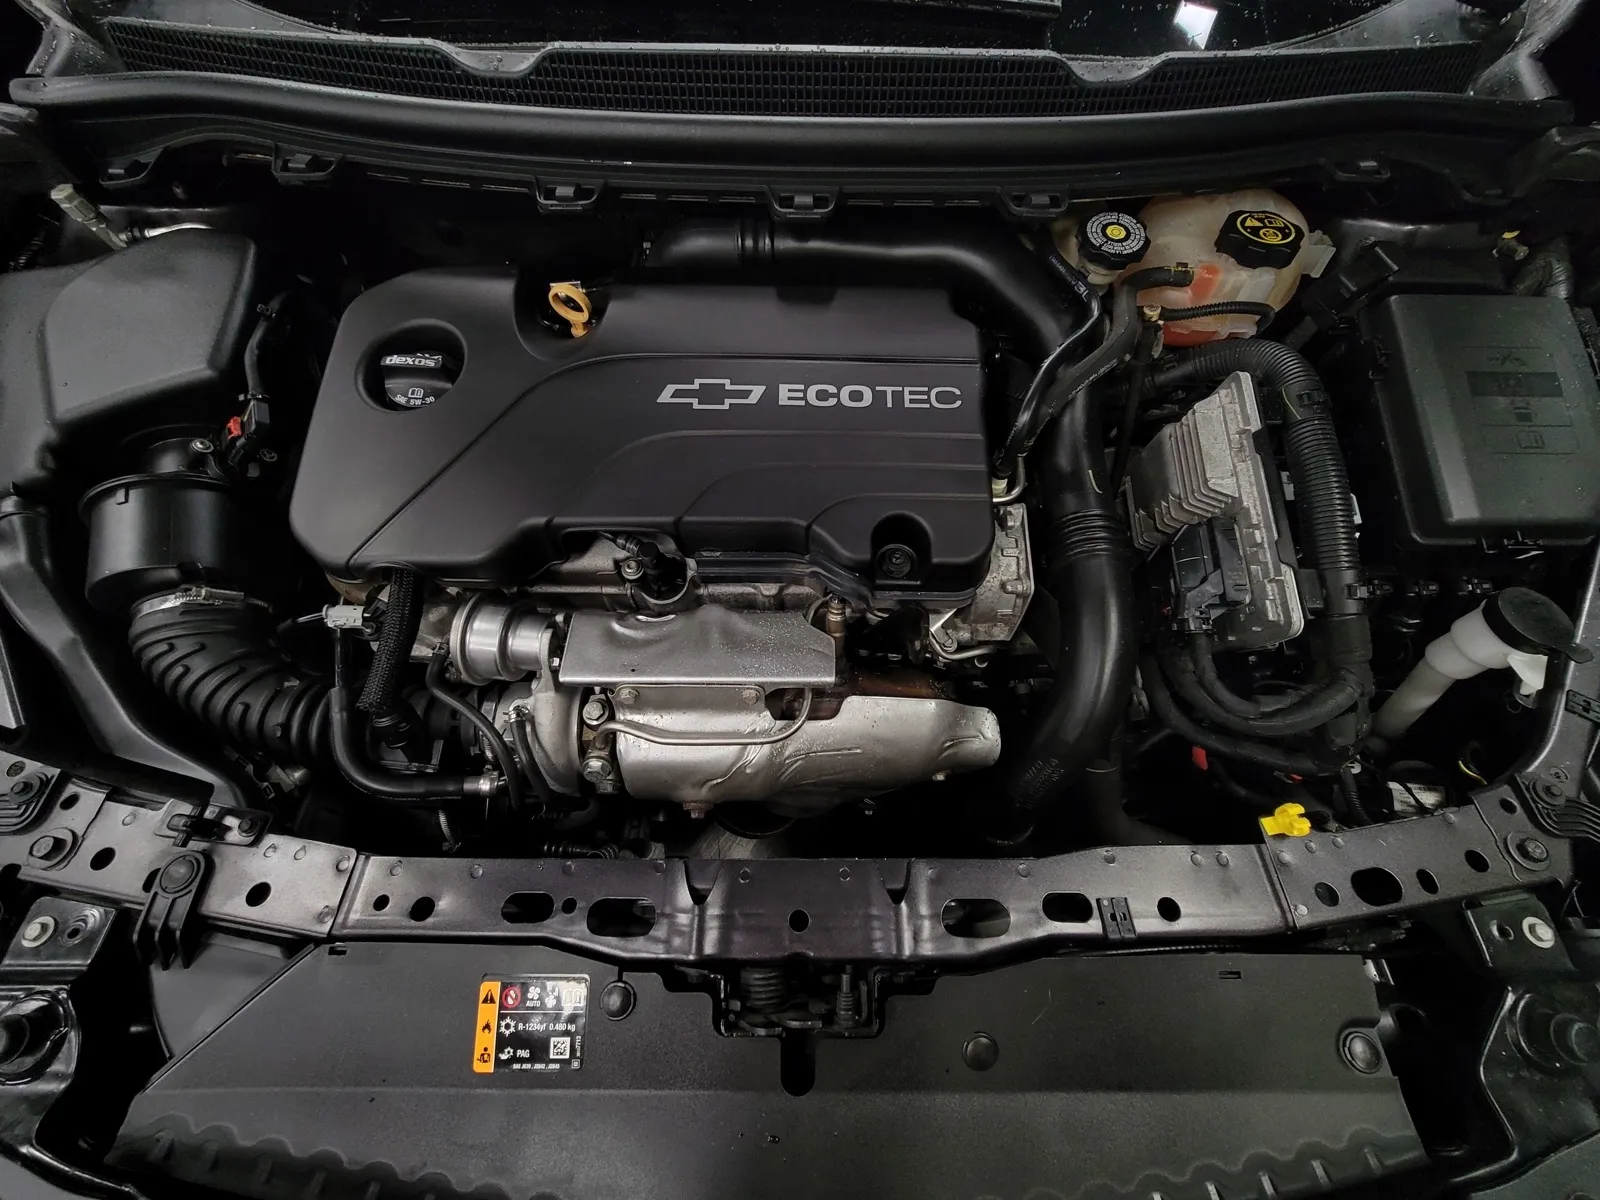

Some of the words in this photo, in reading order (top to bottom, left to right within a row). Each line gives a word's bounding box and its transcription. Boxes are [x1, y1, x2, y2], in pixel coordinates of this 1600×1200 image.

[385, 354, 435, 367] dexos
[395, 394, 408, 404] SAE
[409, 396, 435, 405] 5W-30
[778, 383, 963, 409] ECOTEC
[518, 1023, 546, 1032] R-1234yf
[567, 1023, 576, 1032] kg
[517, 1049, 530, 1058] PAG
